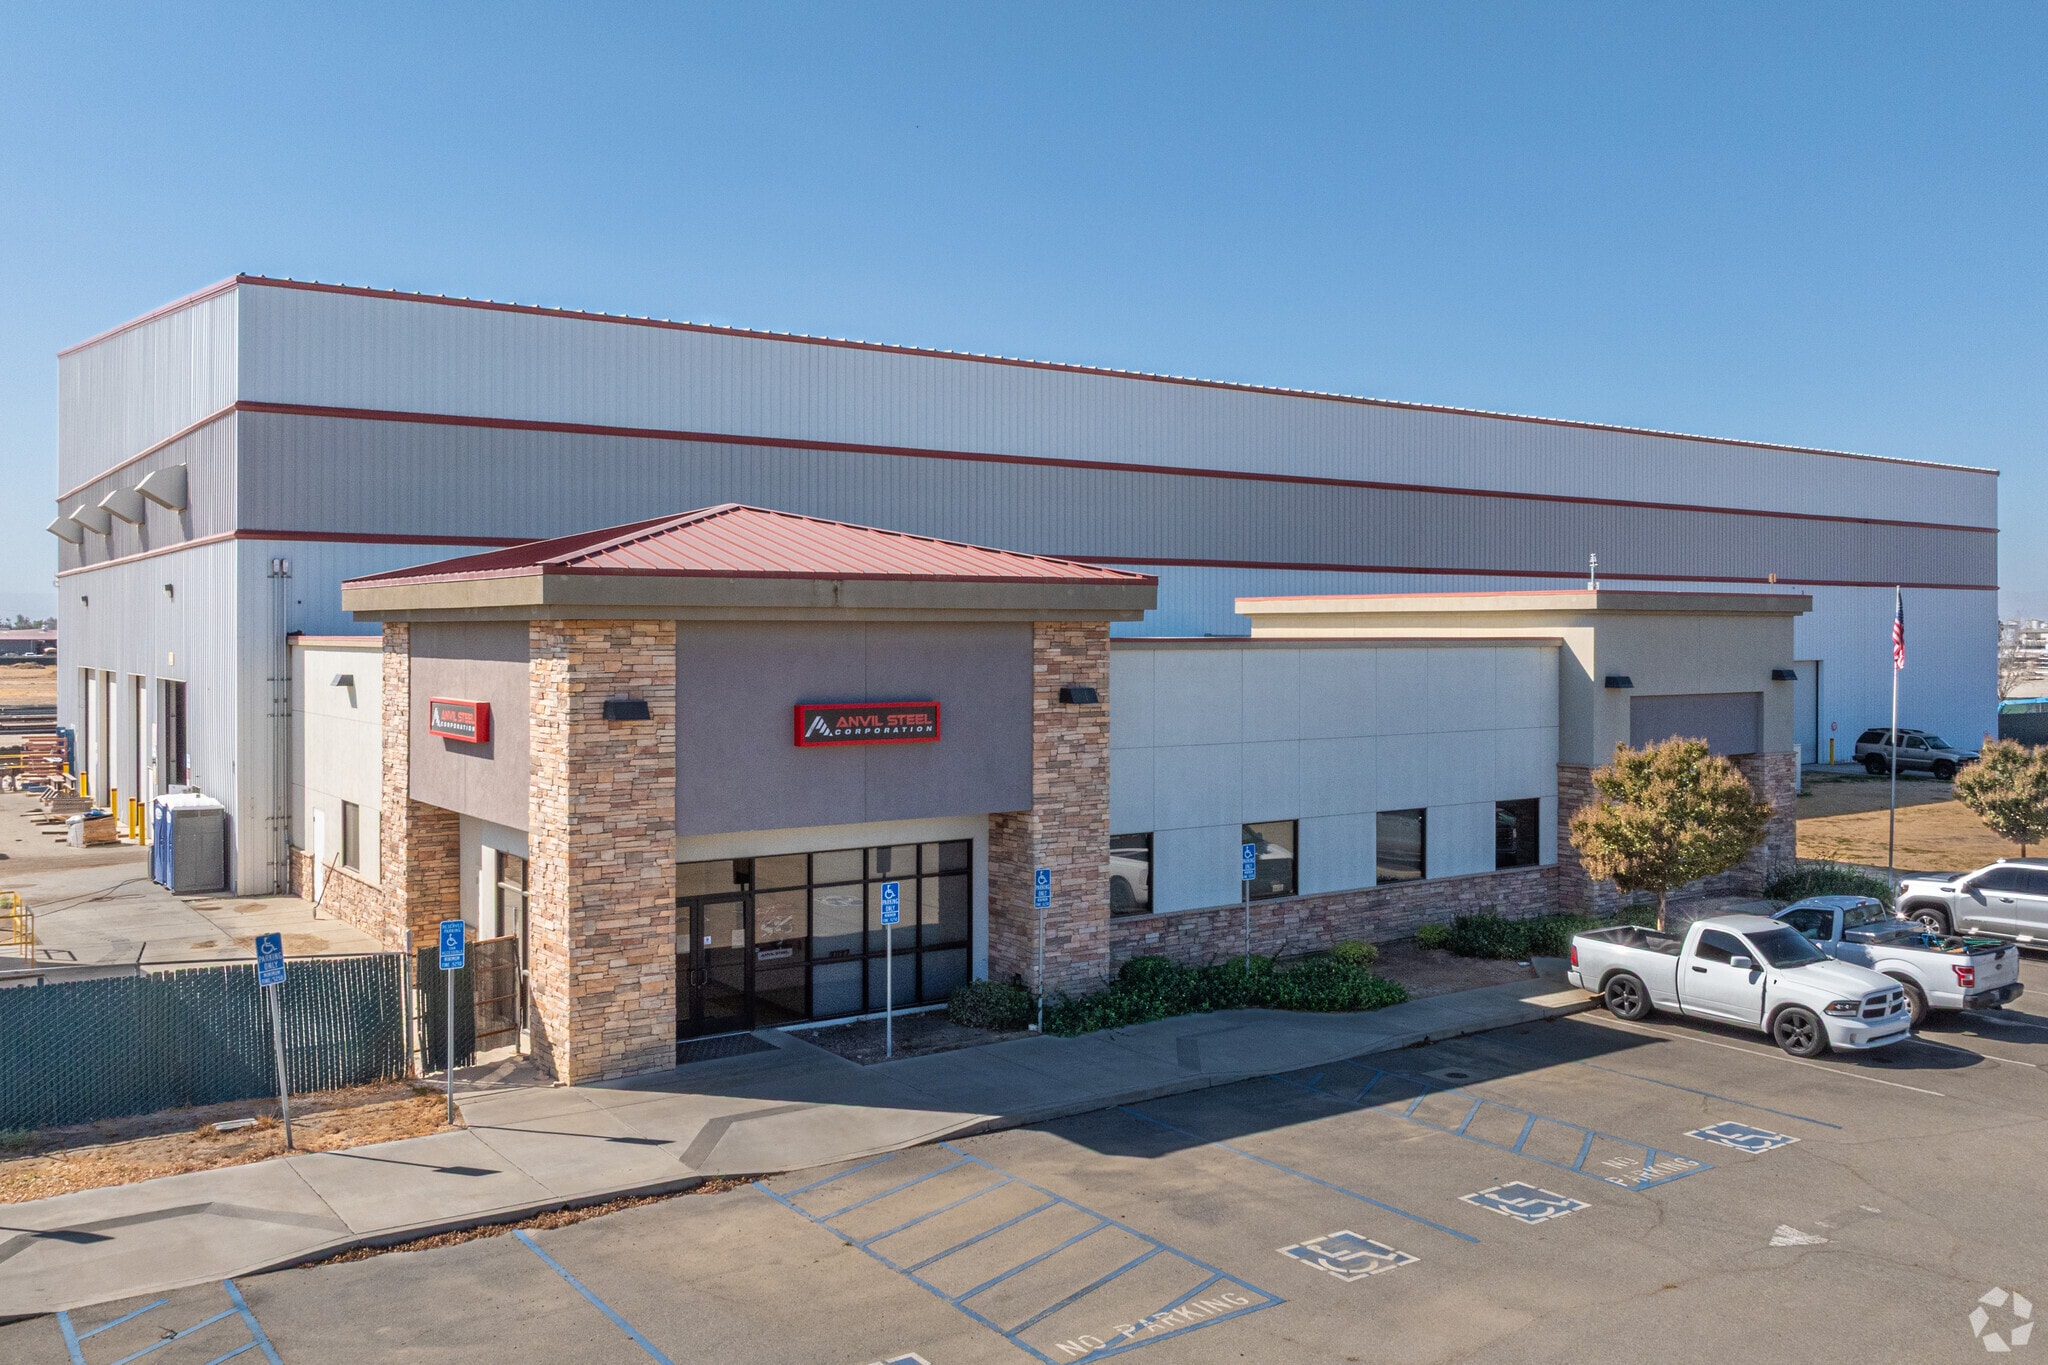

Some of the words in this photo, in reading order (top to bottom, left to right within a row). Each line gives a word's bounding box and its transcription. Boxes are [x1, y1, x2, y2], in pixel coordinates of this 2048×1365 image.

[441, 709, 457, 722] ANVIL
[457, 711, 475, 725] STEEL
[836, 716, 884, 728] ANVIL
[887, 713, 932, 726] STEEL
[439, 720, 475, 732] CORPORATION
[834, 725, 933, 736] CORPORATION
[258, 952, 283, 963] PARKING
[264, 961, 279, 971] ONLY
[1601, 1156, 1639, 1169] NO
[1604, 1157, 1699, 1187] PARKING
[1055, 1334, 1106, 1357] NO
[1113, 1292, 1249, 1339] PARKING
